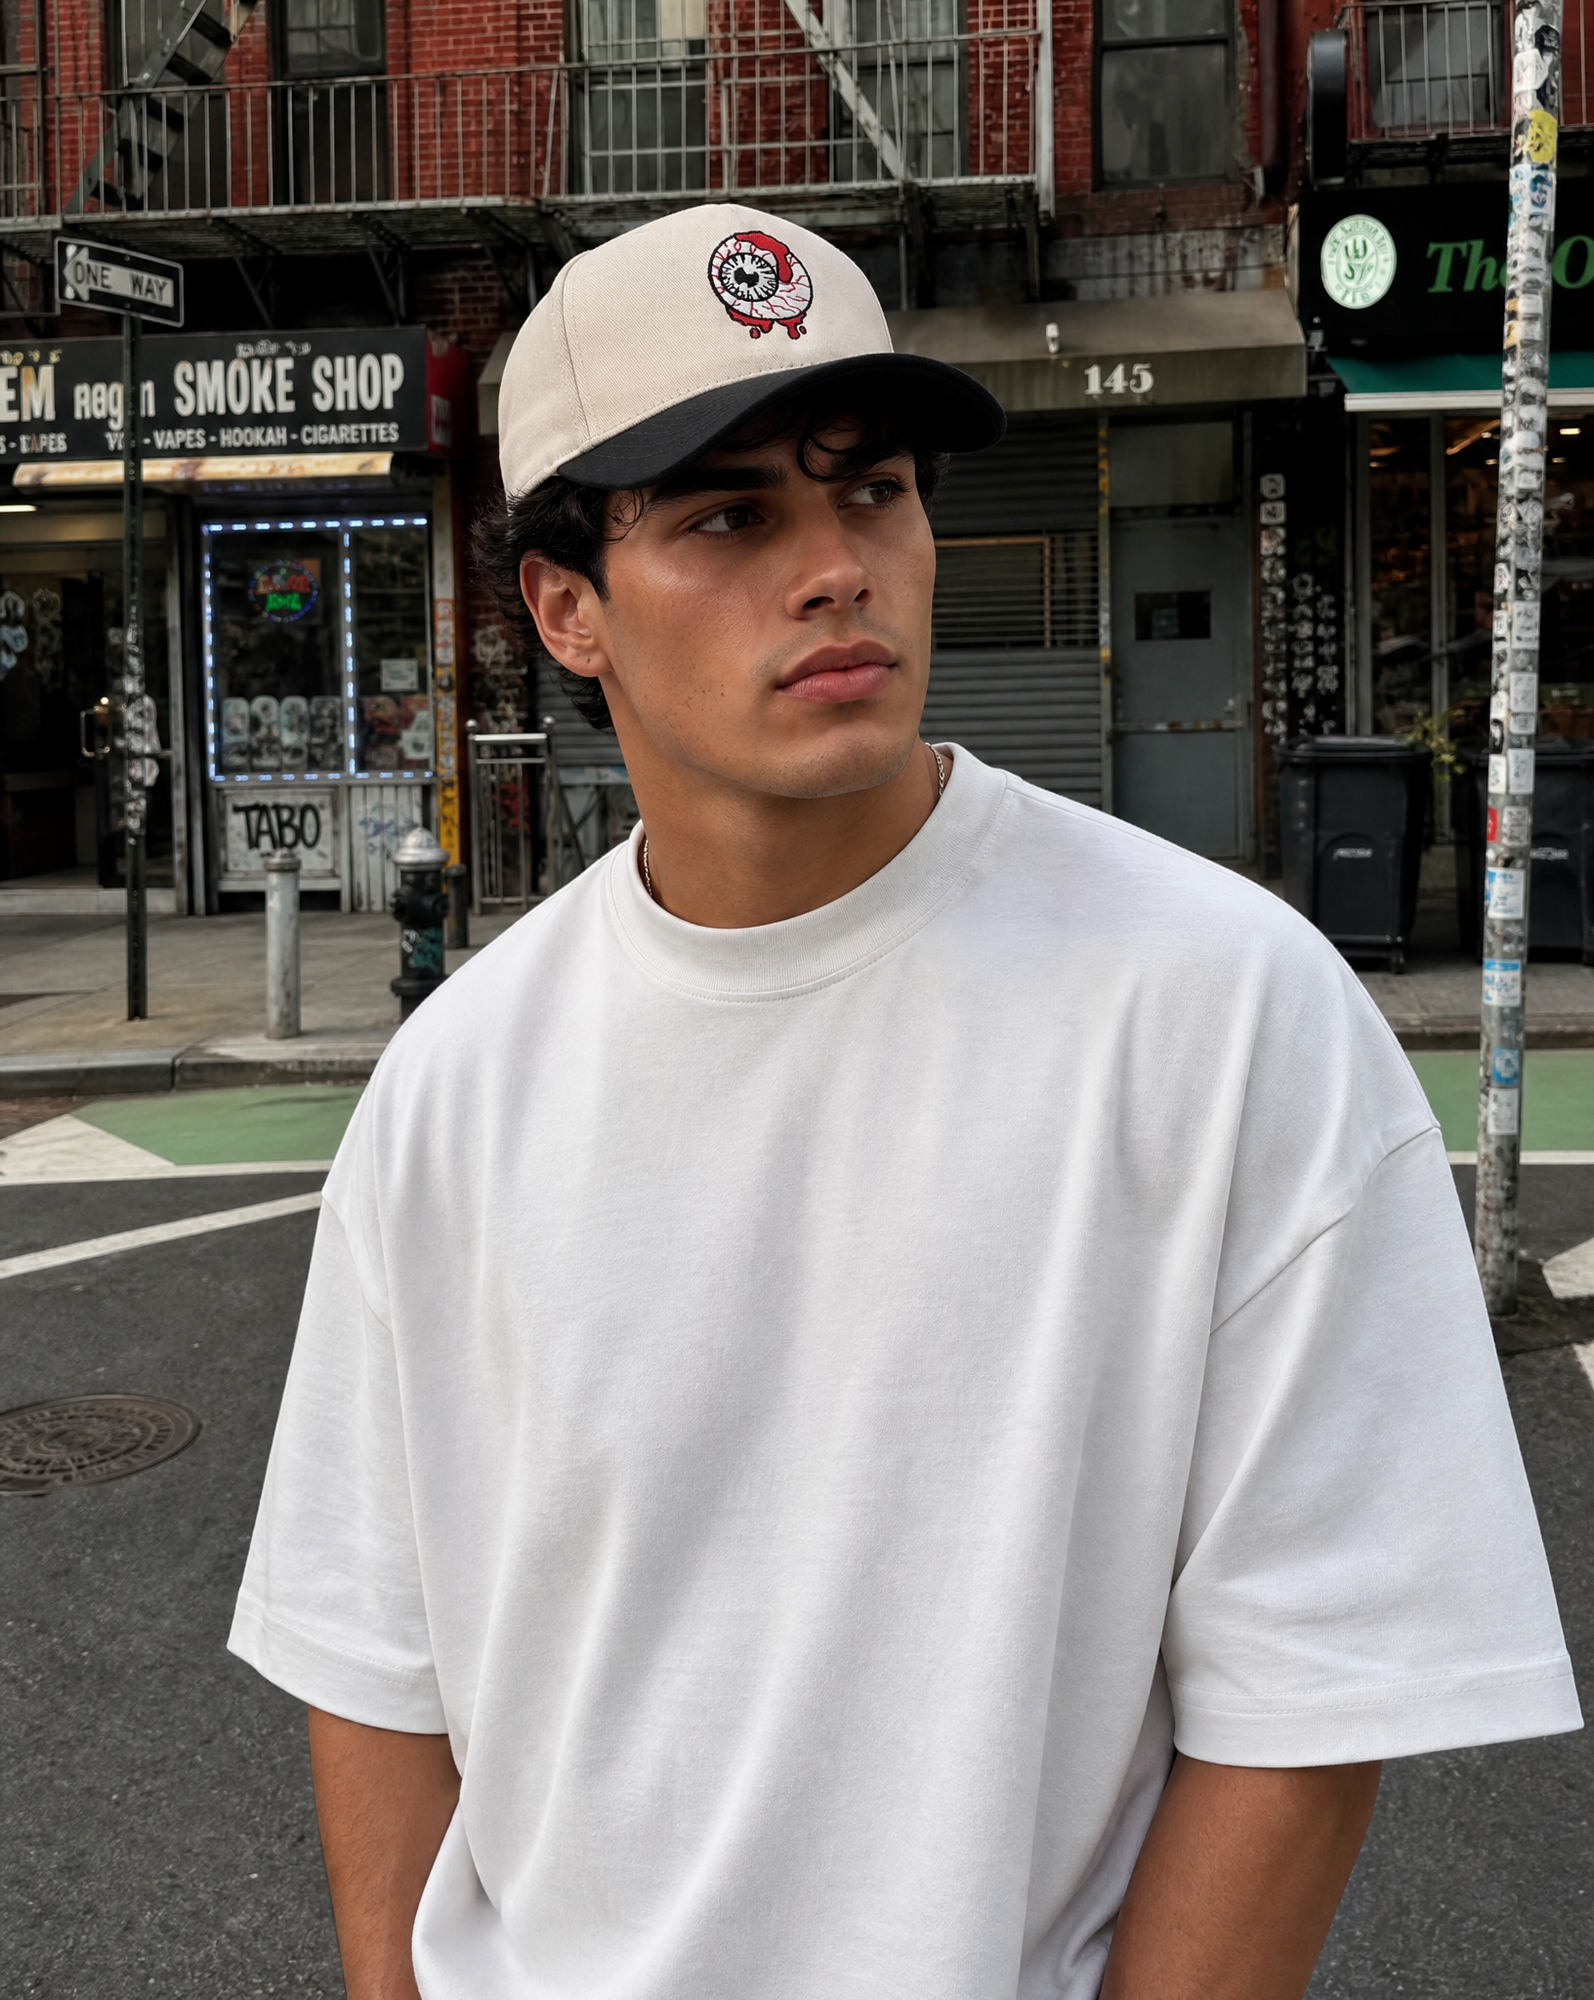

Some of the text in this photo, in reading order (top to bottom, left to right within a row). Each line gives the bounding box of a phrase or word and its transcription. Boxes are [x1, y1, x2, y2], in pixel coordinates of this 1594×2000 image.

[75, 260, 168, 302] ONE WAY
[174, 357, 296, 416] SMOKE
[312, 353, 404, 412] SHOP
[1084, 363, 1154, 395] 145
[153, 428, 206, 449] VAPES
[219, 426, 287, 448] HOOKAH
[300, 422, 399, 446] CIGARETTES
[233, 803, 321, 850] TABO
